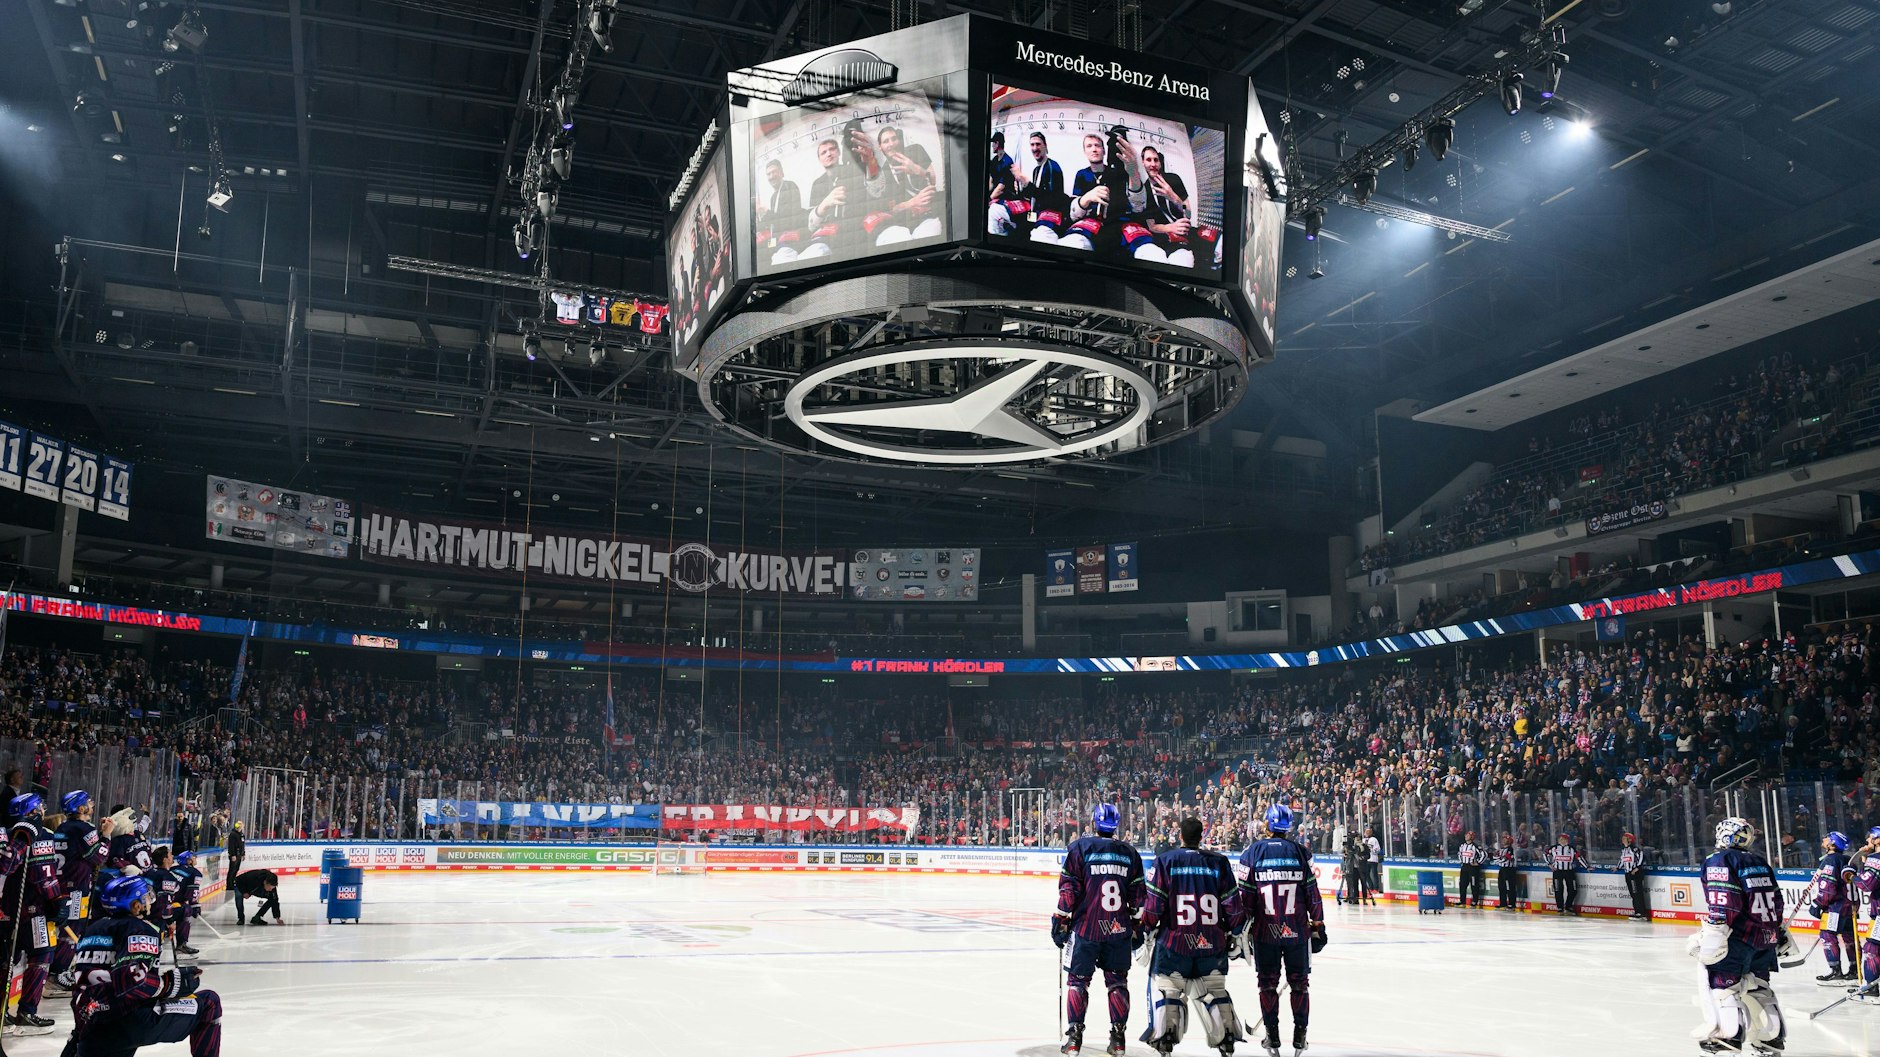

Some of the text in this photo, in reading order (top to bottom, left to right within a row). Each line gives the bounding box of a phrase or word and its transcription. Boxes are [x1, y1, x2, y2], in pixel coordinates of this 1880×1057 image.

[1016, 40, 1211, 101] Mercedes-Benz Arena
[27, 442, 62, 484] 27
[64, 454, 98, 494] 20
[103, 467, 129, 505] 14
[1601, 504, 1649, 523] Szene Ost
[1601, 520, 1632, 532] Ortsgruppe
[369, 513, 661, 583] HARTMUT NICKEL
[728, 551, 834, 593] KURVE
[1611, 590, 1677, 616] FRANK
[1681, 571, 1783, 604] HÖRDLER
[31, 595, 104, 621] FRANK
[108, 606, 202, 631] HÖRDLER
[876, 660, 929, 673] FRANK
[933, 658, 1005, 673] HÖRDLER
[34, 840, 54, 849] LIQUI
[34, 847, 55, 855] MOLY
[350, 848, 370, 856] LIQUI
[376, 848, 397, 856] LIQUI
[404, 848, 425, 856] LIQUI
[448, 851, 466, 859] NEU
[468, 851, 505, 860] DENKEN.
[523, 852, 554, 860] VOLLER
[555, 852, 590, 860] ENERGIE.
[596, 850, 678, 862] GASAG
[350, 855, 369, 863] MOLY
[375, 855, 397, 863] MOLY
[403, 855, 425, 863] MOLY
[865, 854, 883, 863] 91.4
[42, 865, 52, 877] 7
[1101, 880, 1122, 912] 8
[1260, 883, 1298, 916] 17
[1596, 891, 1618, 899] Logistik
[1708, 891, 1728, 905] 45
[1176, 893, 1219, 926] 59
[1580, 906, 1602, 914] PENNY.
[1751, 891, 1778, 922] 45
[1653, 910, 1677, 919] PENNY.
[1788, 919, 1815, 928] ENNY.
[129, 936, 158, 946] LIQUI
[129, 944, 159, 954] MOLY
